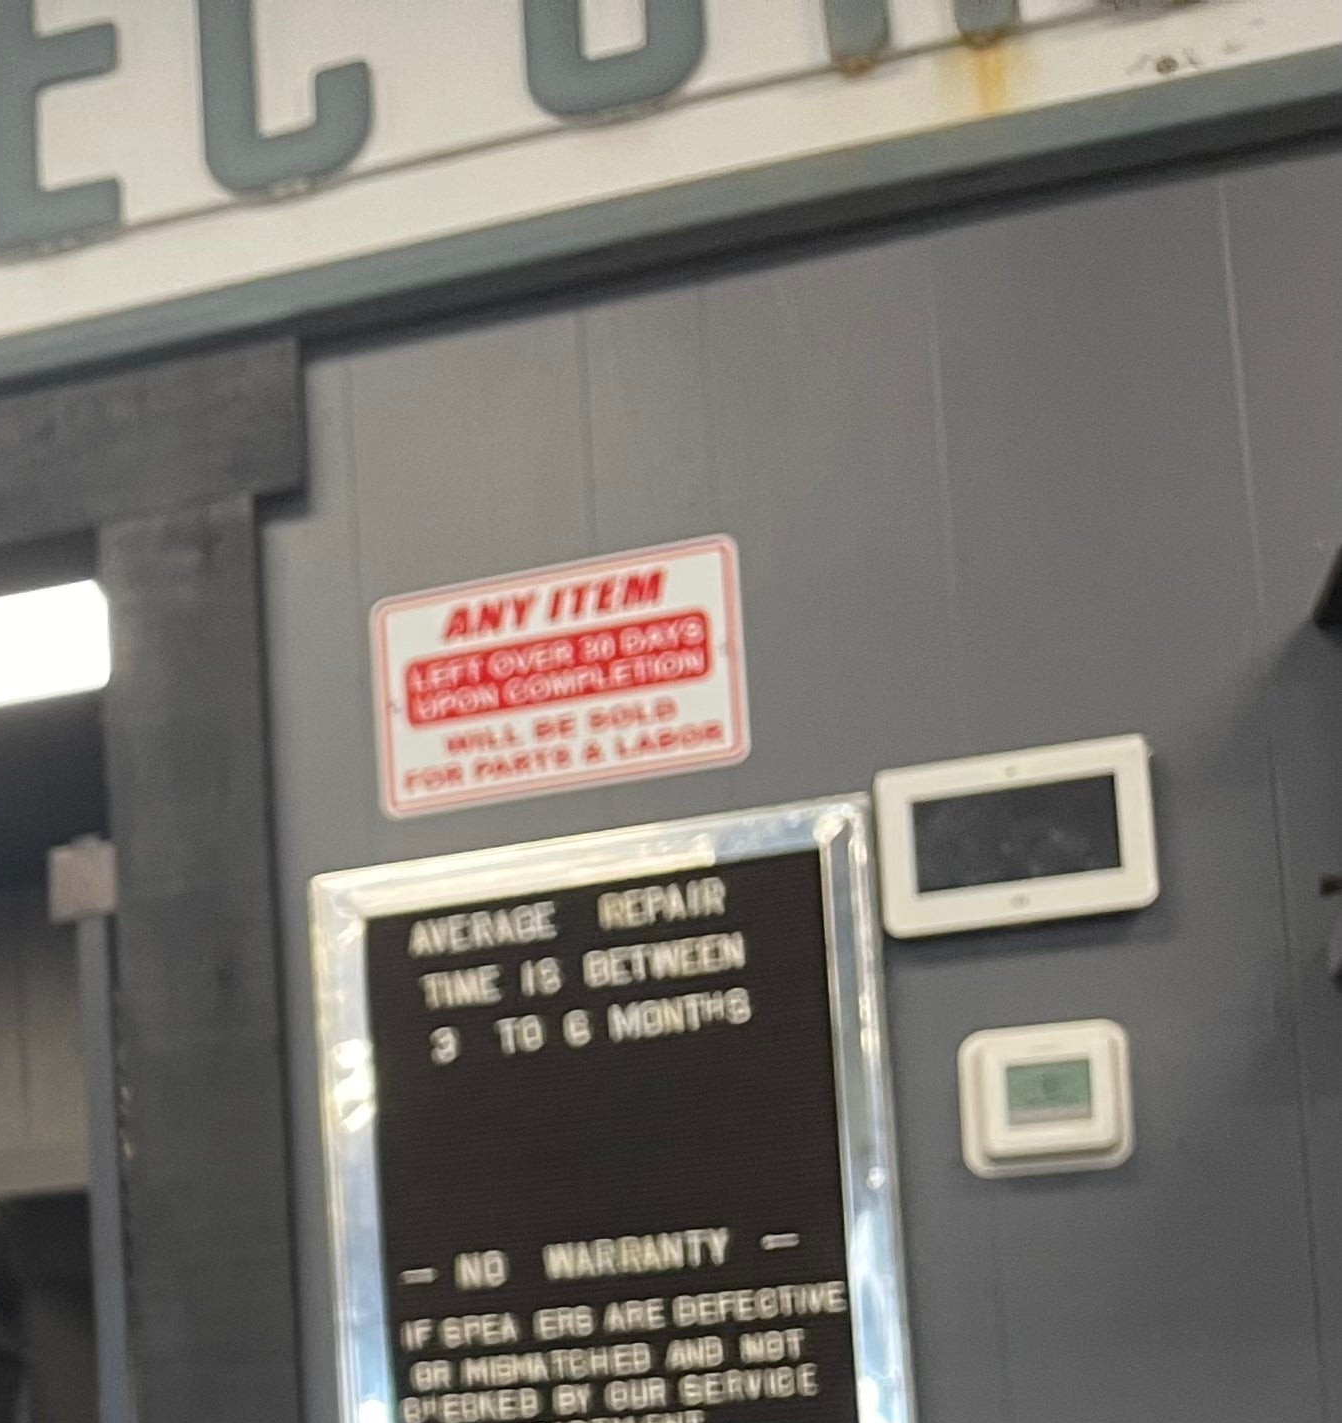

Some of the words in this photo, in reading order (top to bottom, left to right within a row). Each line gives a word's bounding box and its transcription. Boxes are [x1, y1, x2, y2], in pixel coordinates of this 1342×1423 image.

[443, 592, 537, 641] ANY
[548, 568, 664, 622] ITEM
[412, 655, 482, 694] LEFT
[488, 640, 573, 682] OVER
[620, 615, 705, 657] DAYS
[417, 683, 499, 721] UPON
[502, 648, 706, 705] COMPLETION
[404, 764, 462, 793] FOR
[474, 745, 571, 777] PARTS
[618, 720, 723, 757] LABOR
[446, 724, 521, 753] WILL
[534, 714, 575, 741] BE
[588, 698, 676, 732] SOLD
[408, 901, 558, 959] AVERAGE
[597, 877, 726, 931] REPAIR
[419, 964, 503, 1011] TIME
[520, 957, 563, 998] IS
[582, 931, 746, 989] BETWEEN
[429, 1026, 460, 1065] 3
[494, 1014, 546, 1055] TO
[562, 1009, 591, 1048] 6
[607, 987, 752, 1043] MONTHS
[454, 1250, 509, 1290] NO
[542, 1227, 729, 1281] WARRANTY
[401, 1318, 433, 1350] IF
[604, 1298, 666, 1333] ARE
[672, 1280, 848, 1328] DEFECTIVE
[410, 1359, 452, 1392] OR
[460, 1342, 651, 1387] MISMATCHED
[666, 1335, 724, 1371] AND
[739, 1328, 805, 1364] NOT
[552, 1383, 592, 1416] BY
[604, 1376, 666, 1412] OUR
[678, 1362, 819, 1407] SERVICE
